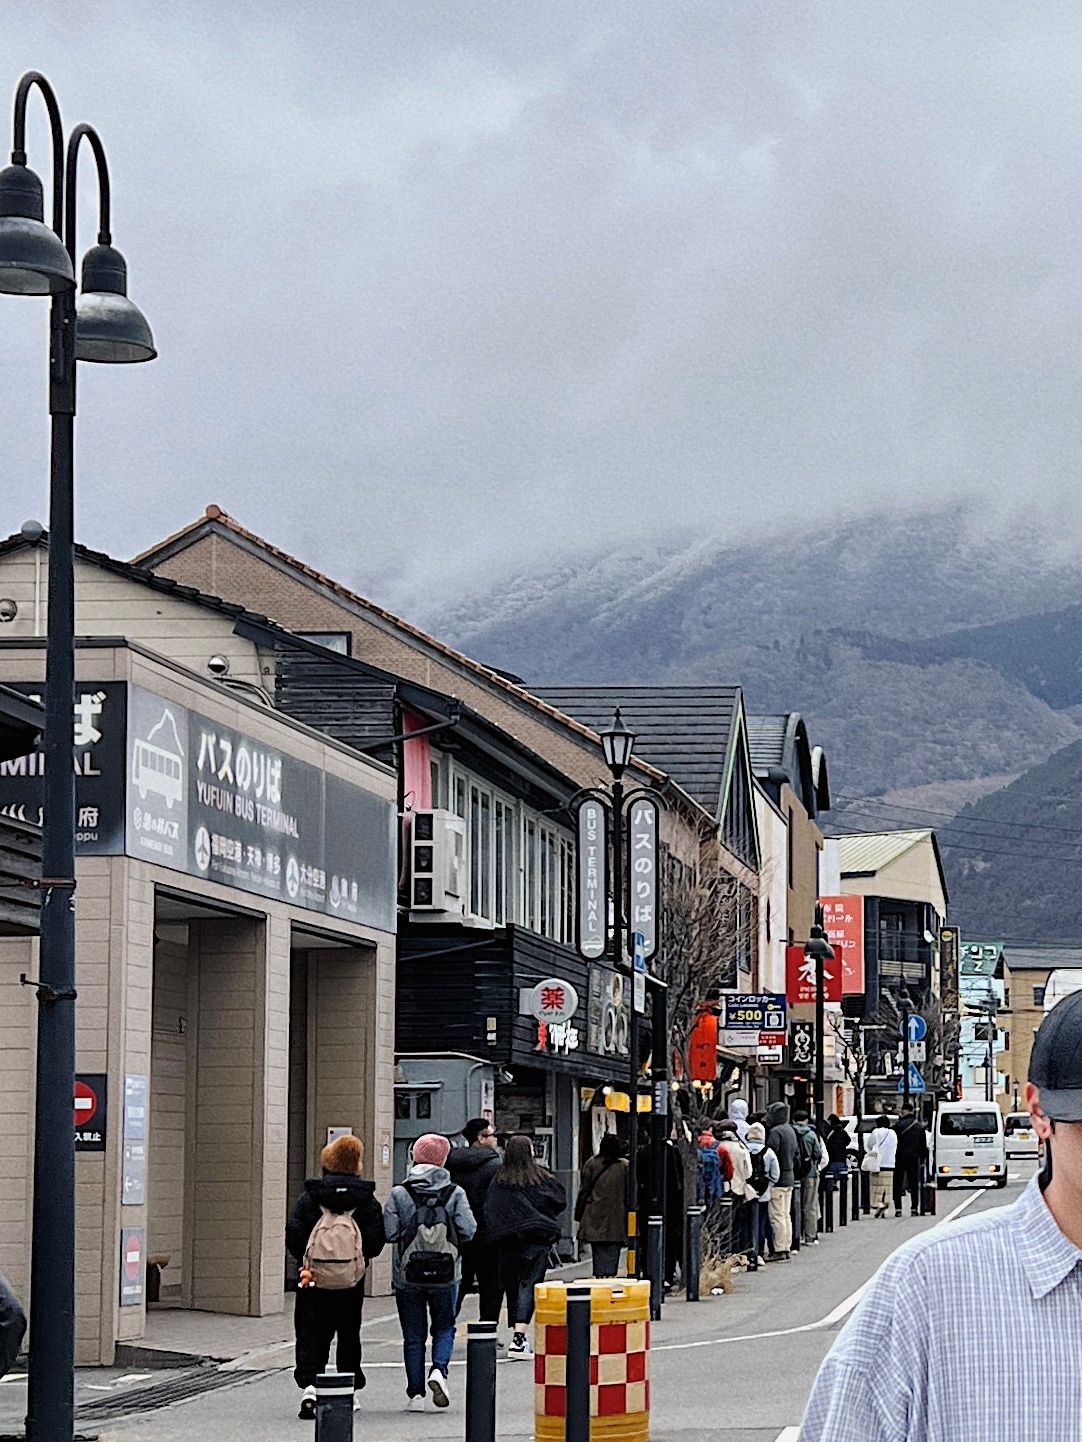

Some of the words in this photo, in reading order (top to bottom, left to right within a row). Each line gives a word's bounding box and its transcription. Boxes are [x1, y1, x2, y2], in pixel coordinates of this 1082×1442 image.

[197, 733, 282, 804] バスのりば
[197, 779, 234, 816] YUFUIN
[234, 795, 255, 822] BUS
[256, 802, 299, 839] TERMINAL
[586, 808, 597, 841] BUS
[587, 846, 598, 932] TERMINAL
[634, 809, 653, 923] バスのりば
[541, 986, 565, 1010] 薬
[727, 995, 777, 1004] コインロッカー
